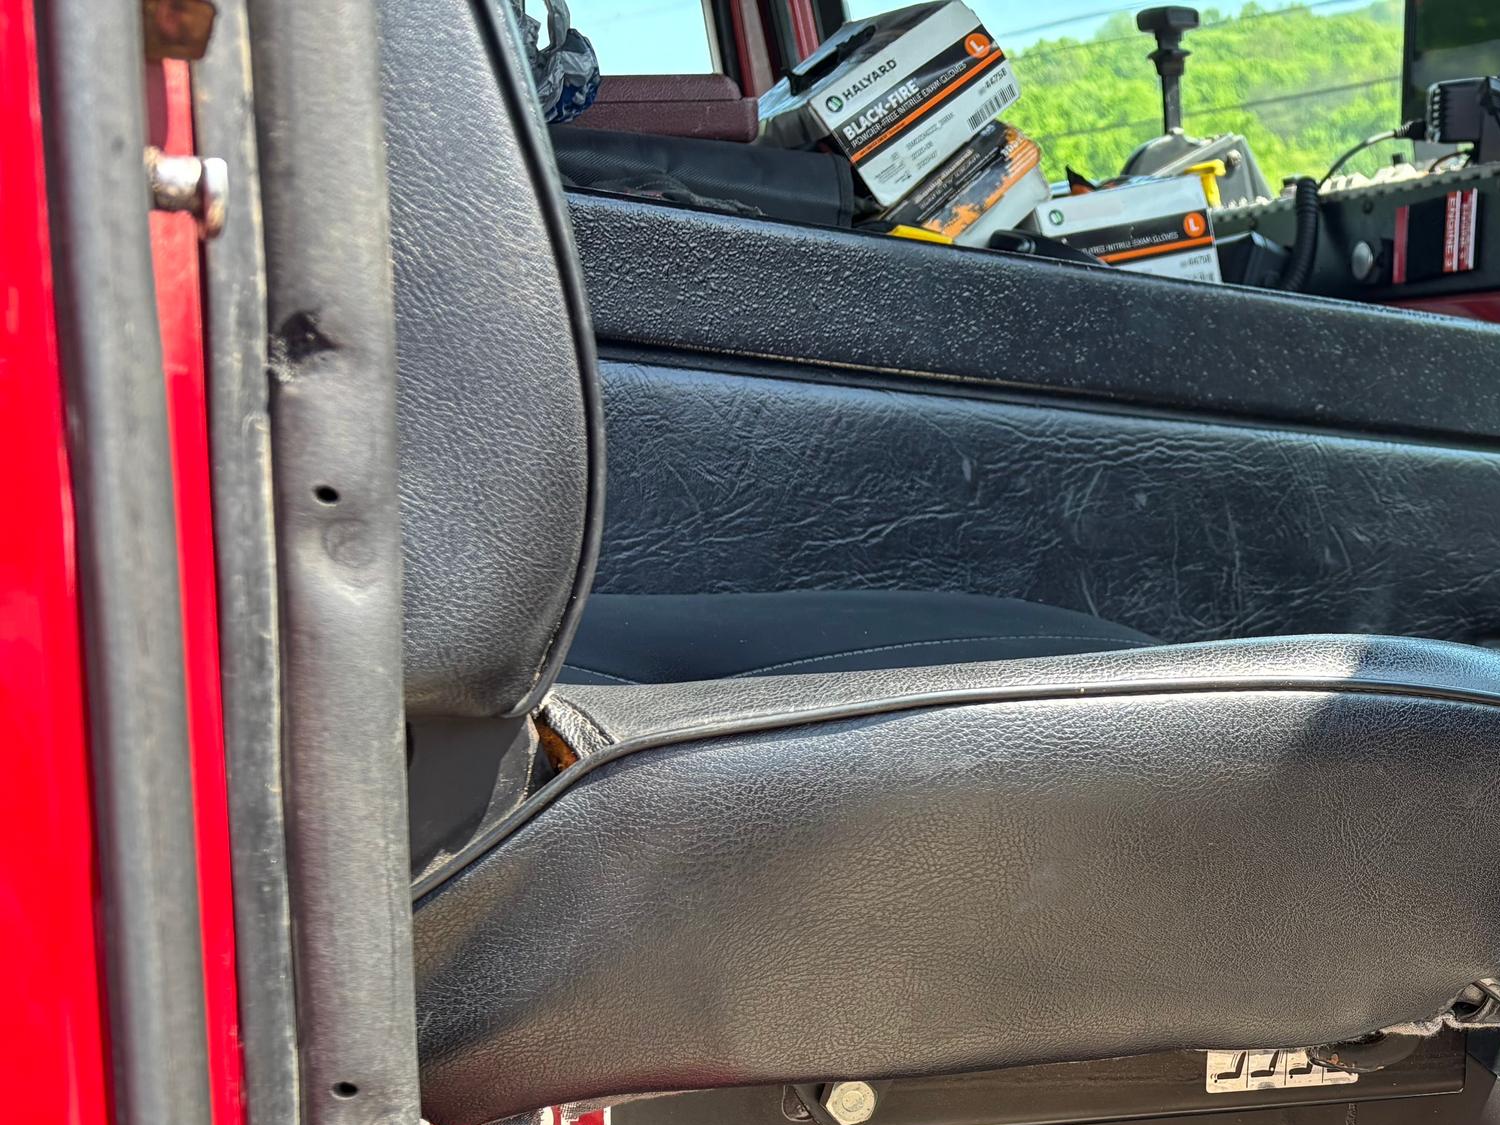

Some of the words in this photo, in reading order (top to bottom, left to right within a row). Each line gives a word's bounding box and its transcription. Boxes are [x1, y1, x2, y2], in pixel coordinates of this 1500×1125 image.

[969, 39, 985, 53] L
[842, 59, 897, 101] HALYARD
[842, 79, 919, 141] BLACK-FIRE
[851, 111, 900, 149] POWDER-FREE
[898, 91, 923, 114] NITRILE
[940, 62, 967, 84] GLOVES
[1152, 231, 1179, 244] GLOVES
[1188, 217, 1200, 232] L
[1446, 198, 1456, 252] ENGINE
